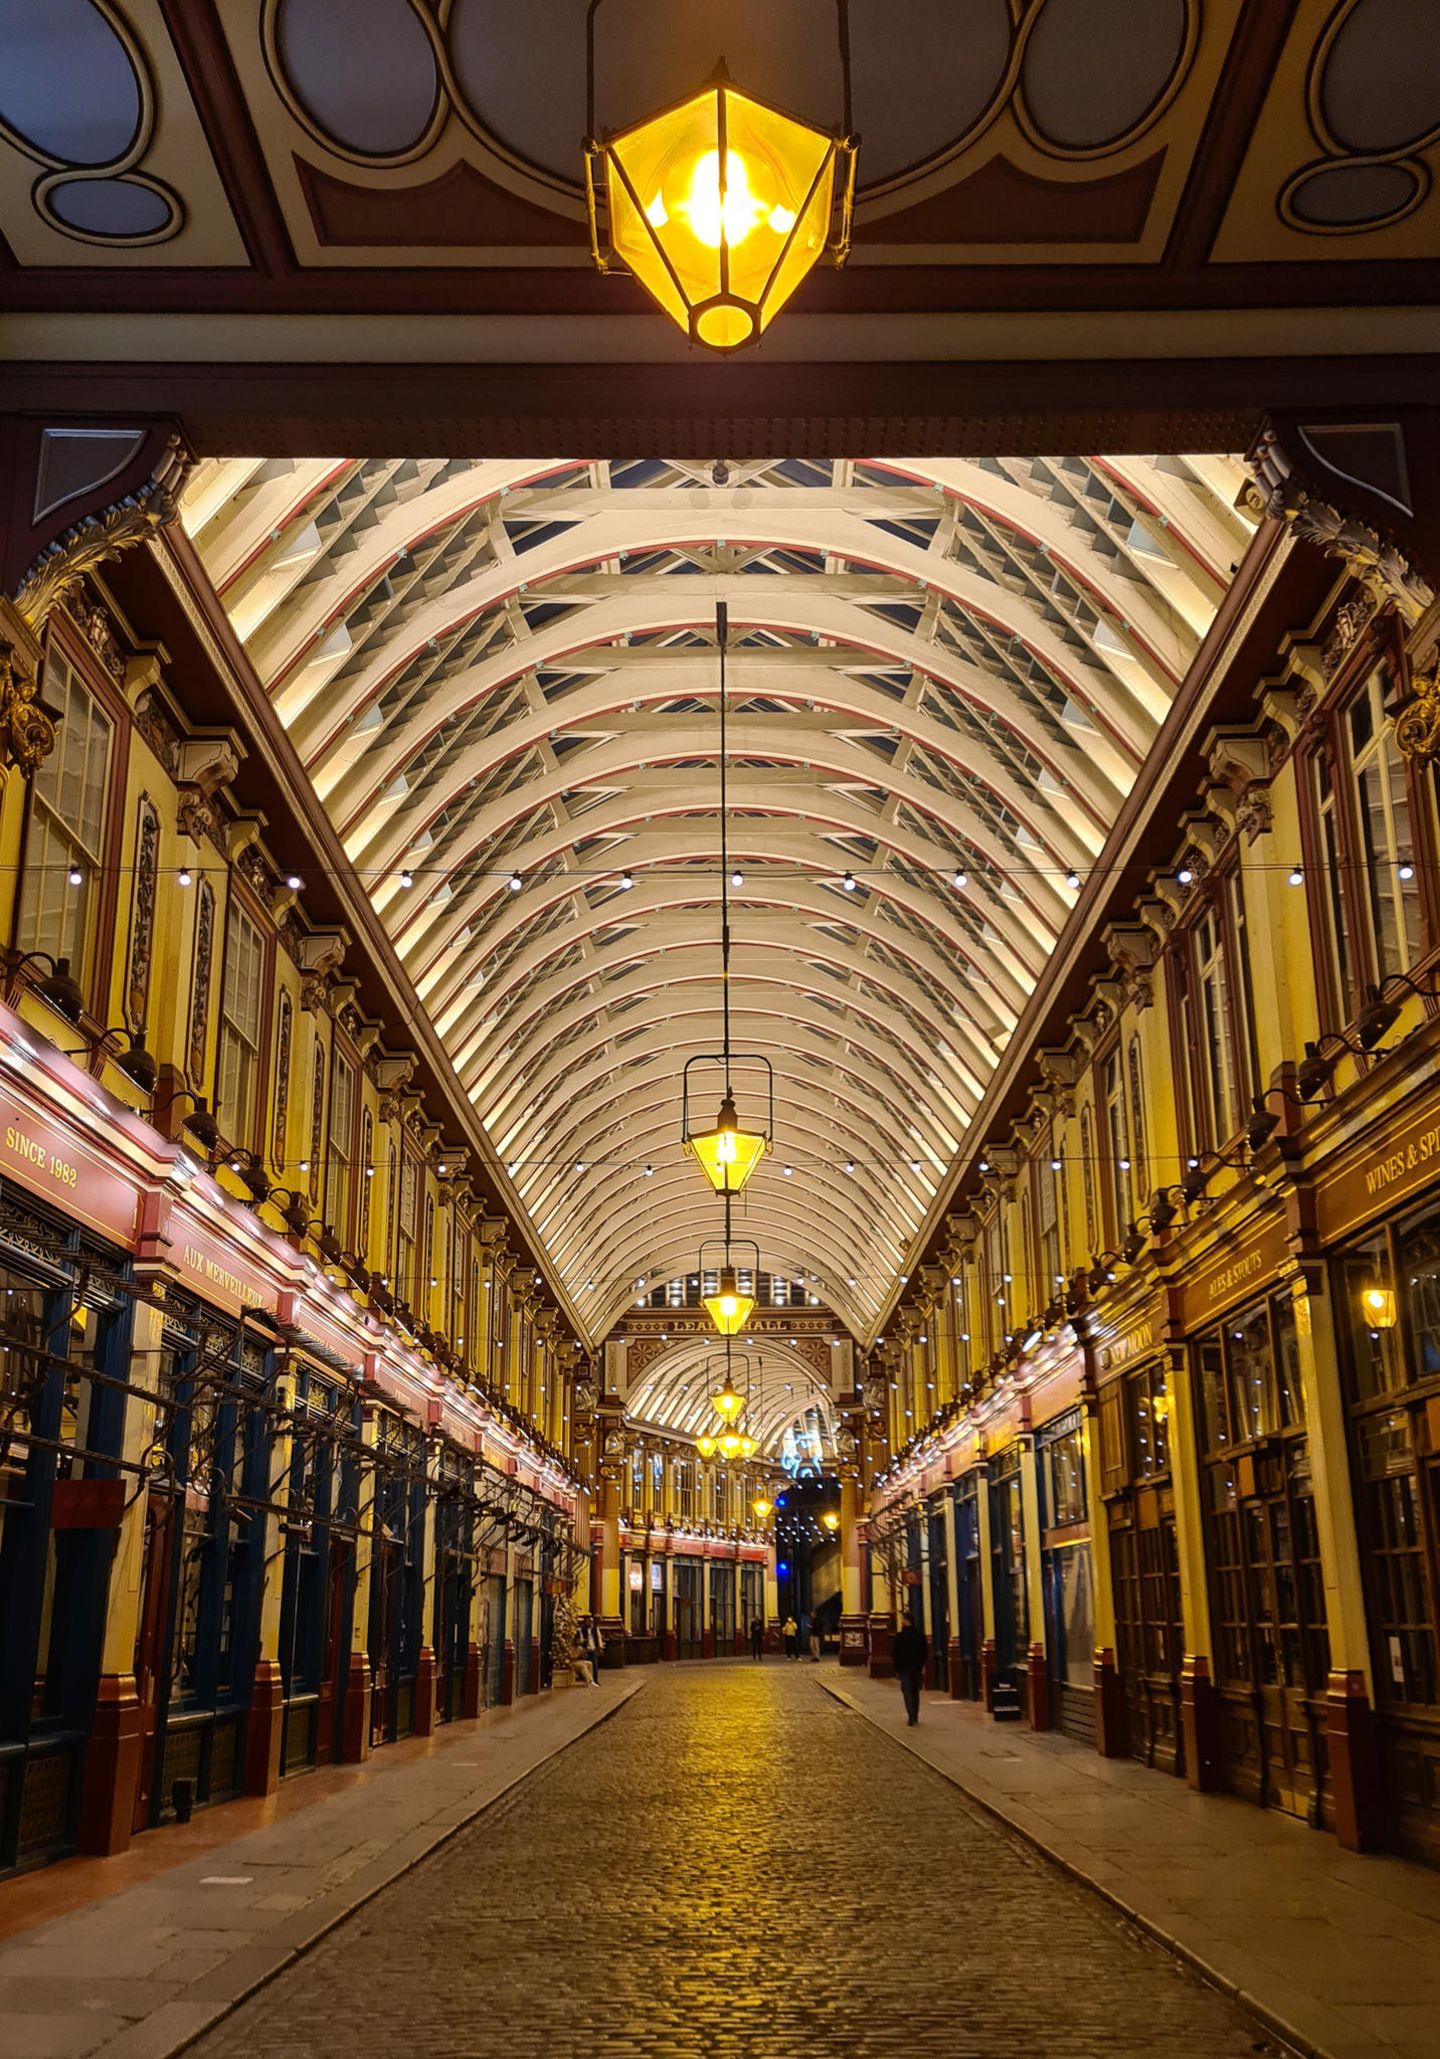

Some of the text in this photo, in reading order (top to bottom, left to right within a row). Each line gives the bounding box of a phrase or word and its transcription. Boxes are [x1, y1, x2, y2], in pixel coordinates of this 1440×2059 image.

[6, 1126, 77, 1188] SINCE 1982
[1366, 1126, 1440, 1195] WINES & SPI
[183, 1244, 263, 1309] AUX MERVEILLEUX
[1209, 1273, 1226, 1300] ALES
[1233, 1249, 1262, 1283] STOUTS
[674, 1320, 787, 1331] LEADHALL
[1110, 1322, 1153, 1367] NEW MOON
